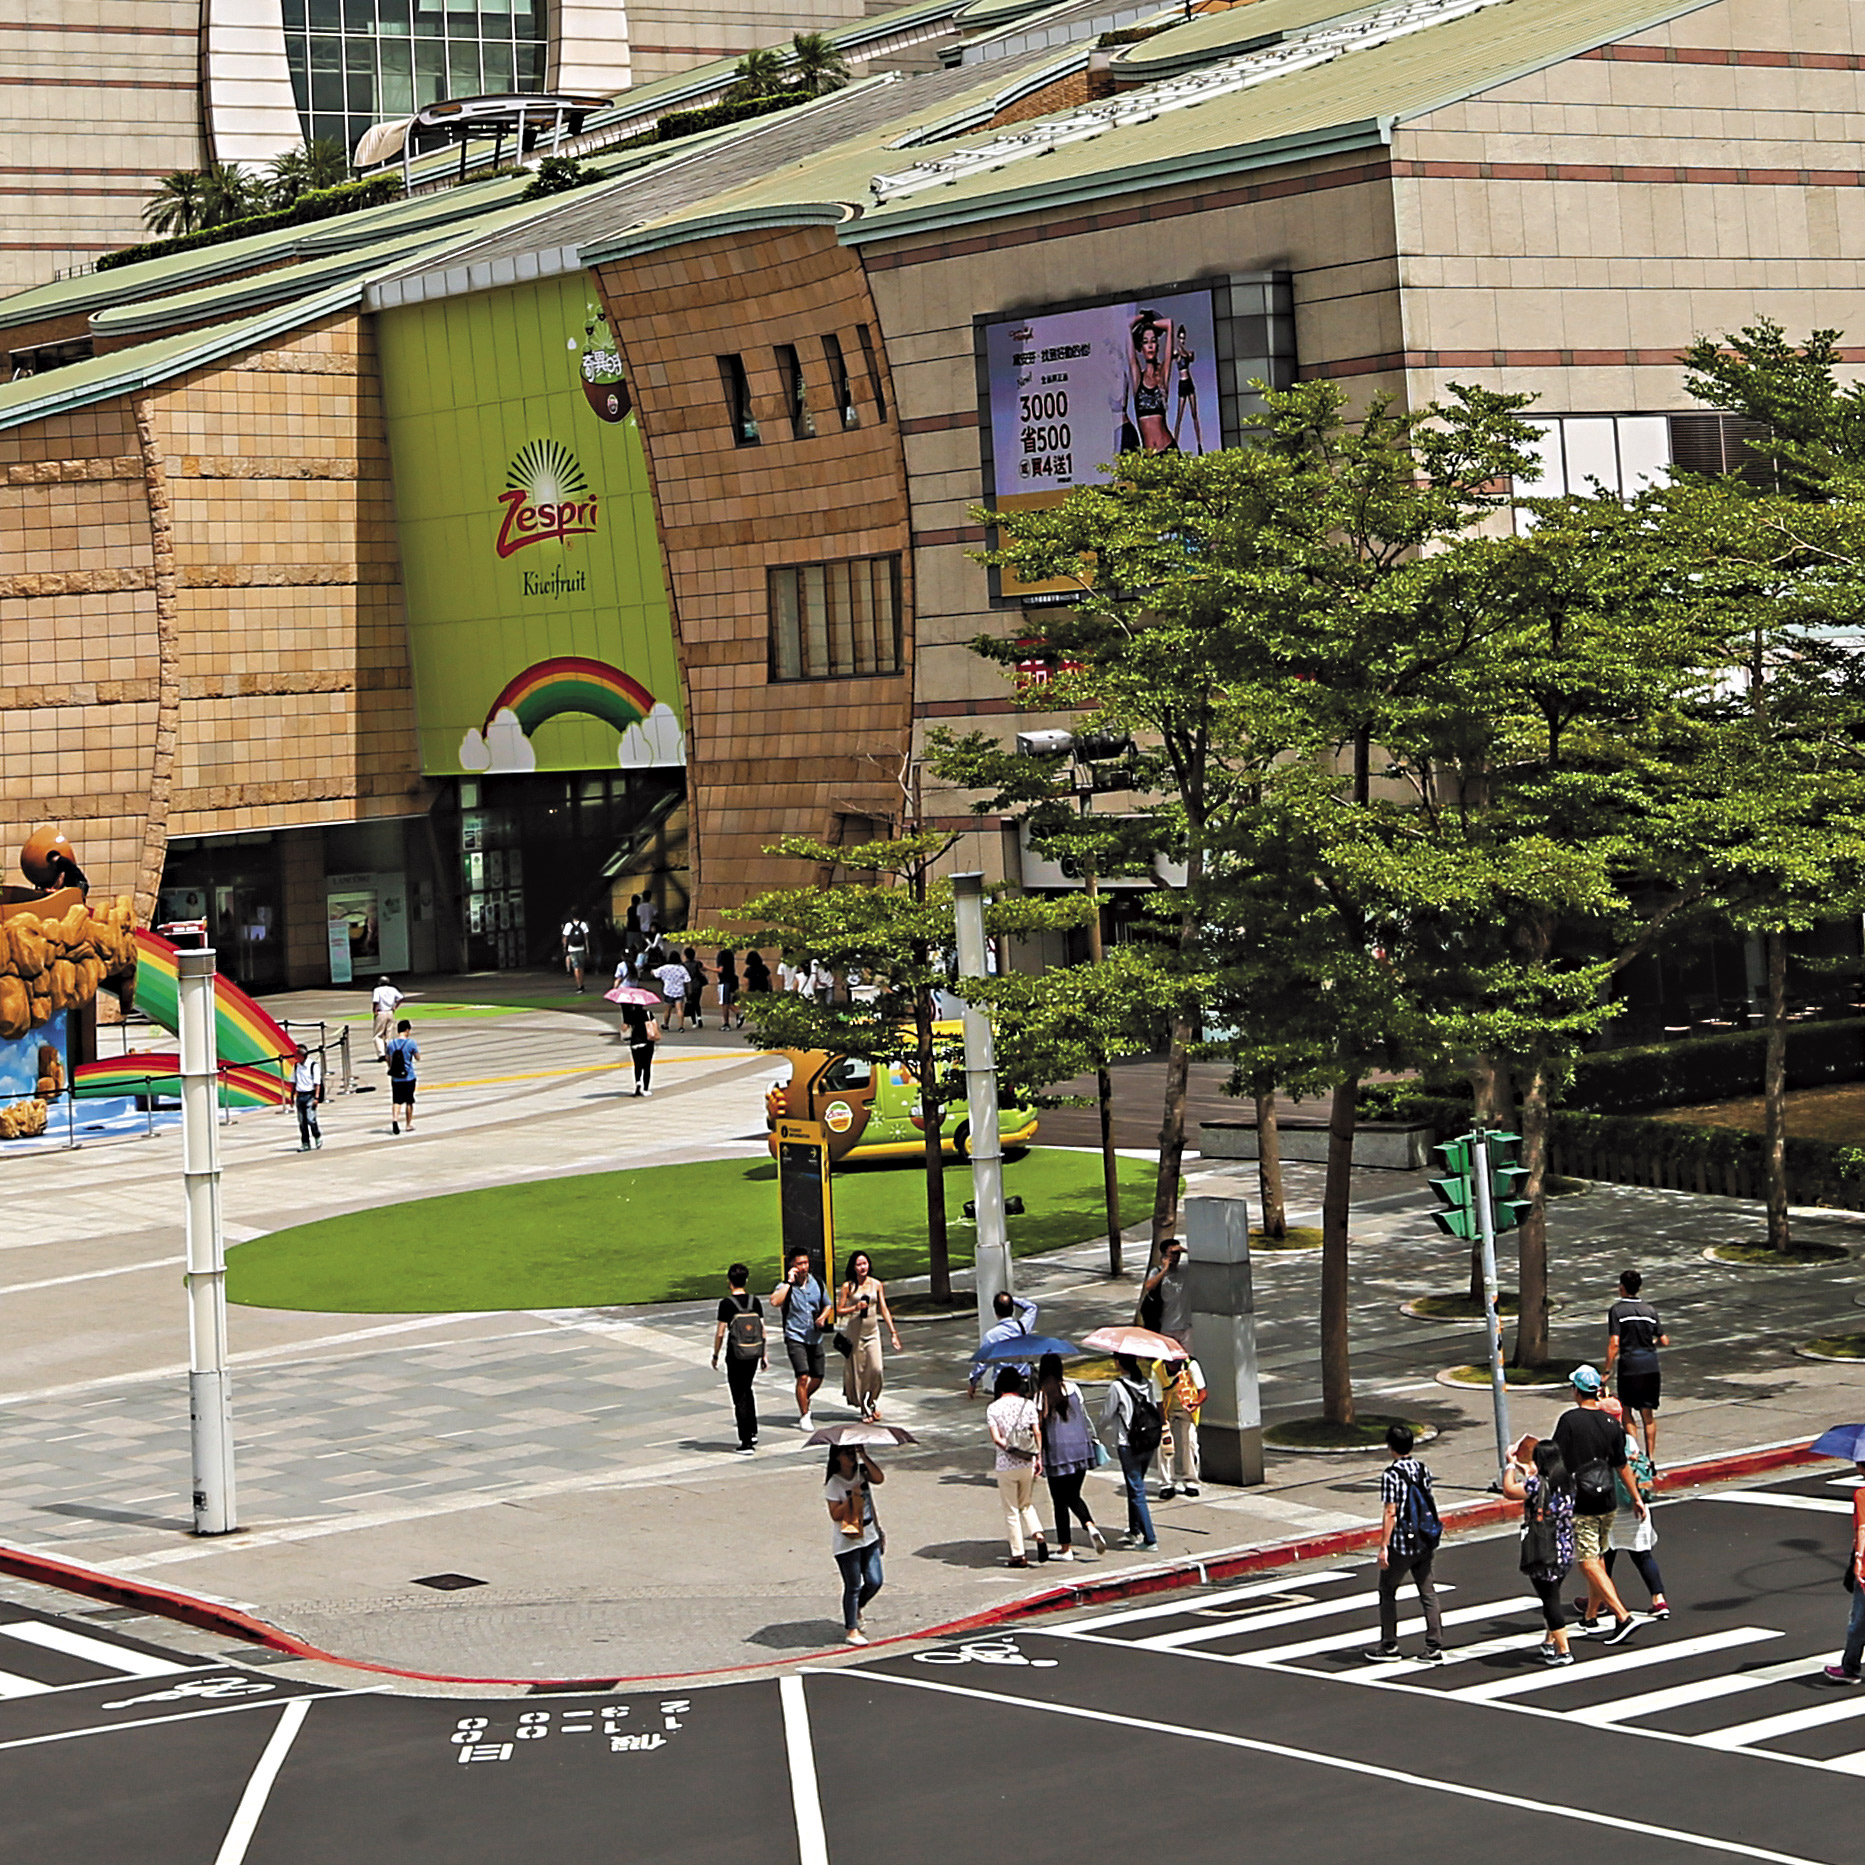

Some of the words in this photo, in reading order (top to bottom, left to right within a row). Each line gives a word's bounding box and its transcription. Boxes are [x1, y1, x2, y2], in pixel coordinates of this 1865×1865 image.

[1020, 391, 1068, 422] 3000
[1021, 424, 1071, 453] 省500
[496, 489, 598, 559] Zespri
[523, 564, 586, 600] Kiwifruit
